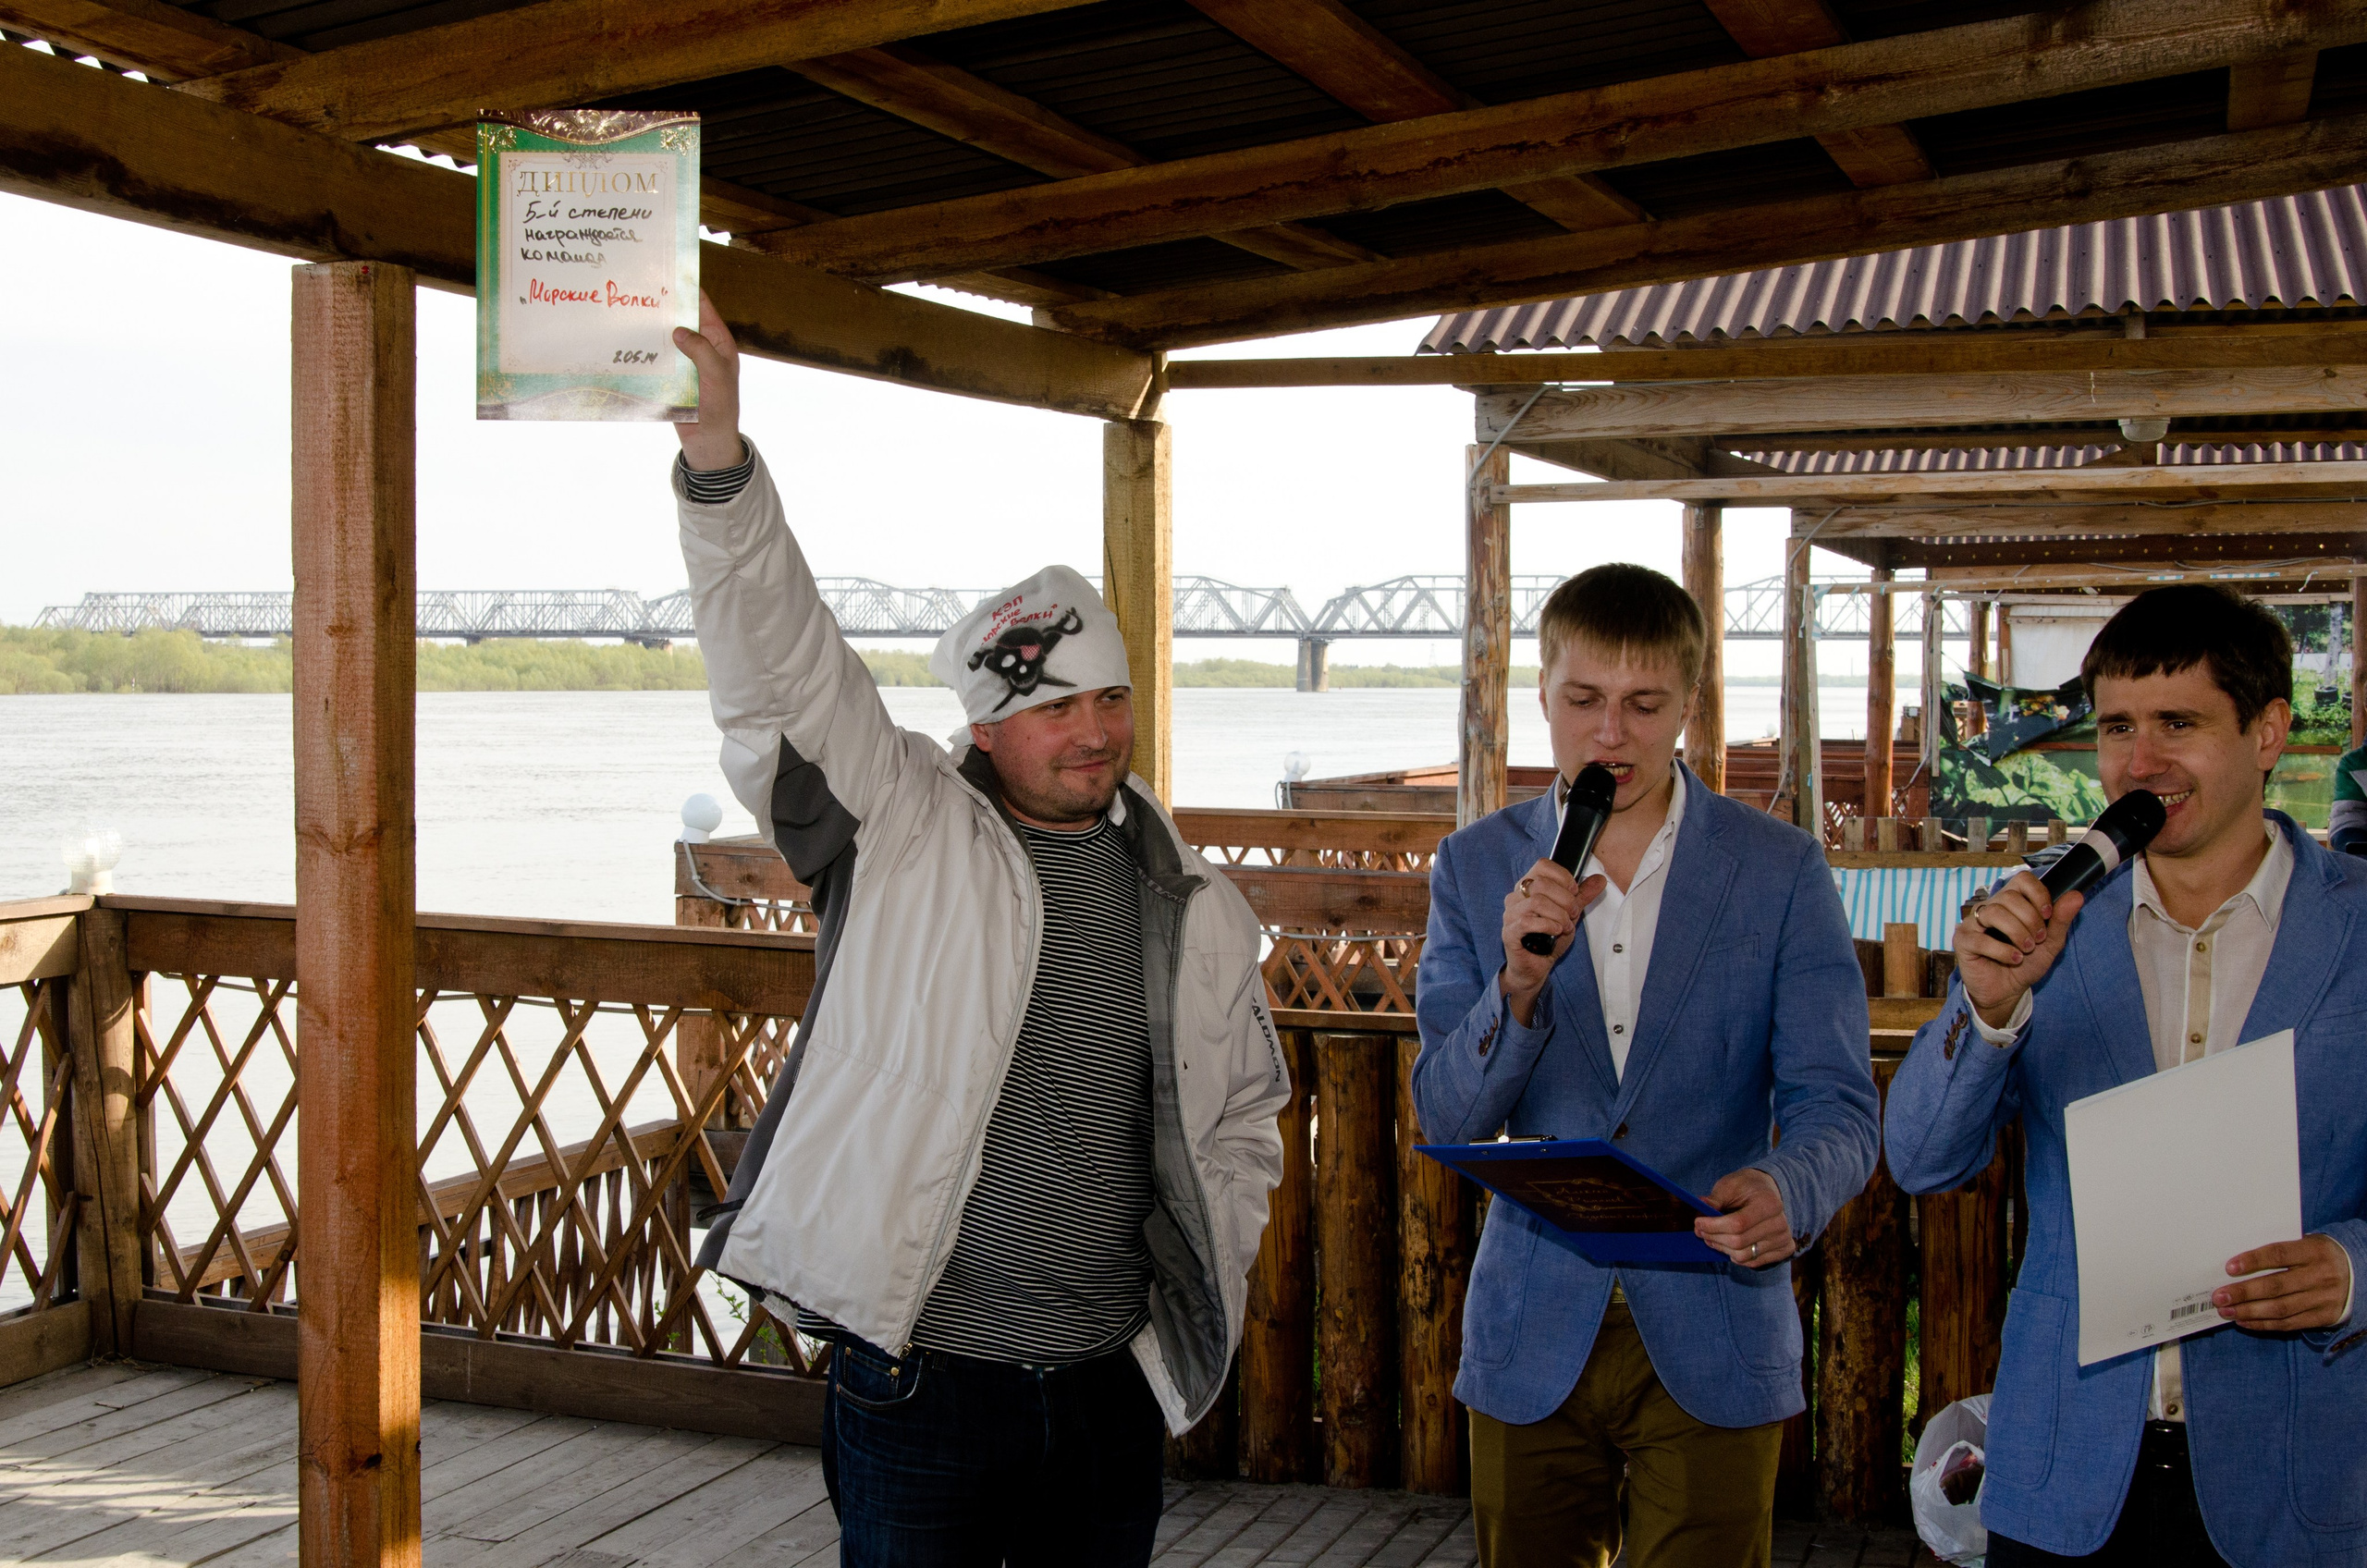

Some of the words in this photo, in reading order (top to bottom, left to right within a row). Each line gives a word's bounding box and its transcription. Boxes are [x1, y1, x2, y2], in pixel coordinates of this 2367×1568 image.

[516, 170, 659, 198] ДИПЛОМ
[568, 206, 653, 220] степени
[1251, 997, 1281, 1083] ALOMON
